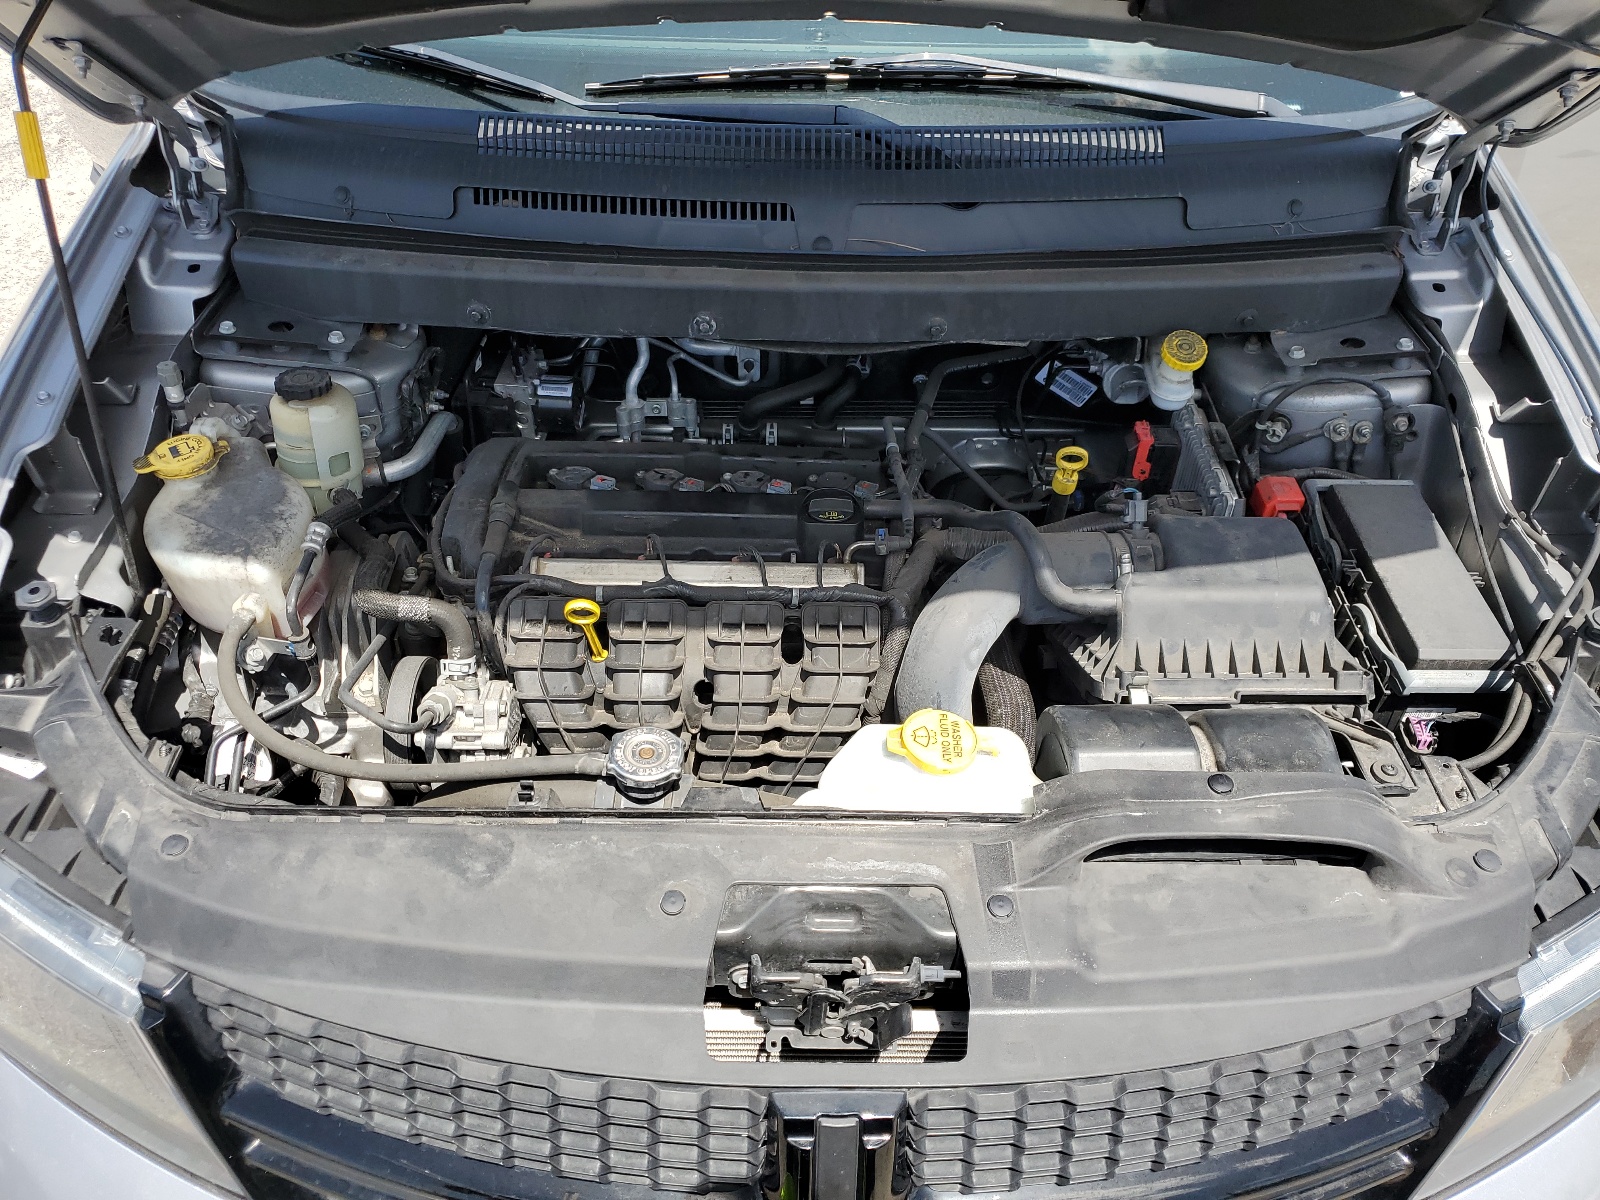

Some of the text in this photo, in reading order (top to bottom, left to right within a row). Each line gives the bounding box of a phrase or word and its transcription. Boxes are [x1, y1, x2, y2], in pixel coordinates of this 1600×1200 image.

[939, 714, 952, 763] FLUID ONLY
[951, 721, 963, 758] WASHER
